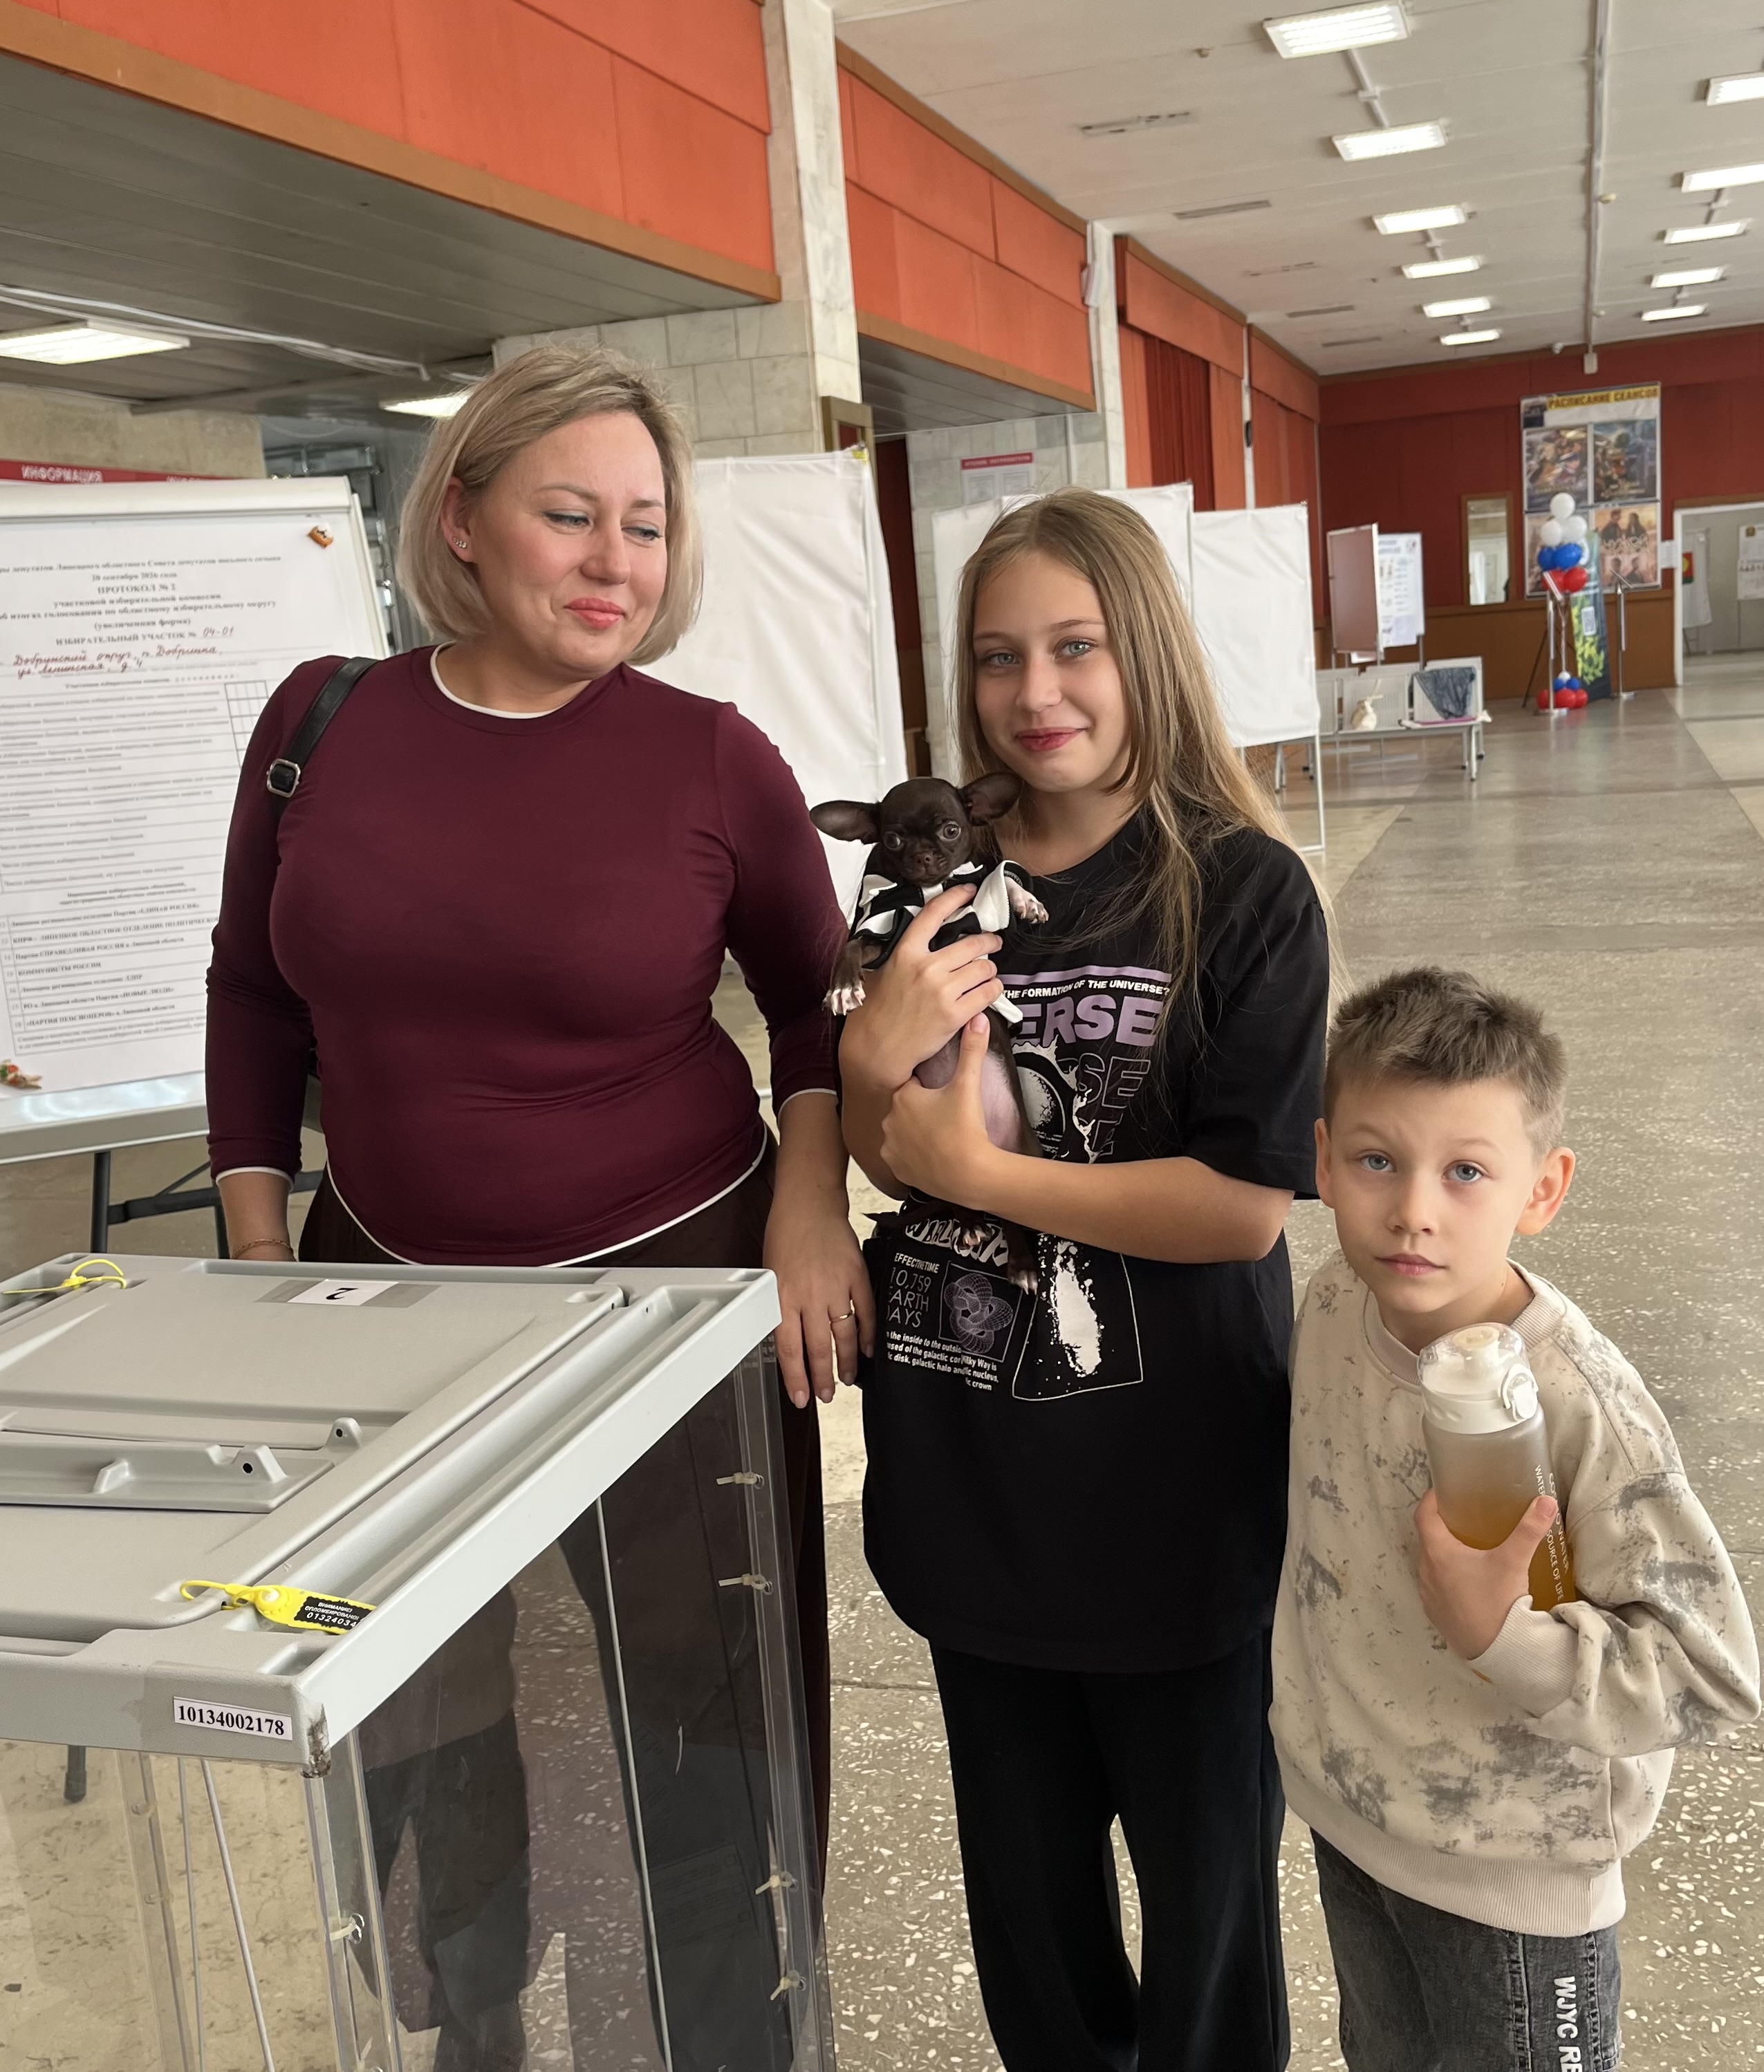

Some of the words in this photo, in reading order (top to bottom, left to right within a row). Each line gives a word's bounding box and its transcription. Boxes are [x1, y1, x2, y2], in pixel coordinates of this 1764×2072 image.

[21, 465, 103, 483] ИНФОРМАЦИЯ
[98, 584, 156, 595] ПРОТОКОЛ
[1003, 989, 1019, 999] THE
[1021, 984, 1073, 998] FORMATION
[1074, 980, 1086, 989] OF
[1088, 980, 1108, 989] THE
[1109, 980, 1170, 996] UNIVERSE?
[326, 1287, 360, 1300] 2
[889, 1286, 929, 1312] ARTH
[886, 1305, 922, 1327] AYS
[890, 1330, 902, 1341] the
[902, 1333, 923, 1345] inside
[923, 1338, 931, 1347] to
[931, 1340, 941, 1349] the
[977, 1359, 991, 1371] Way
[913, 1346, 922, 1355] the
[923, 1350, 948, 1361] galactic
[911, 1358, 936, 1369] galactic
[936, 1362, 951, 1372] halo
[972, 1381, 992, 1390] crown
[1546, 1529, 1558, 1567] SOURCE
[1553, 1567, 1560, 1580] OF
[1555, 1582, 1563, 1601] LIFE
[317, 1602, 353, 1613] ВНИМАНИЕ!
[178, 1705, 285, 1735] 10134002178
[1554, 1976, 1579, 2039] WJYC
